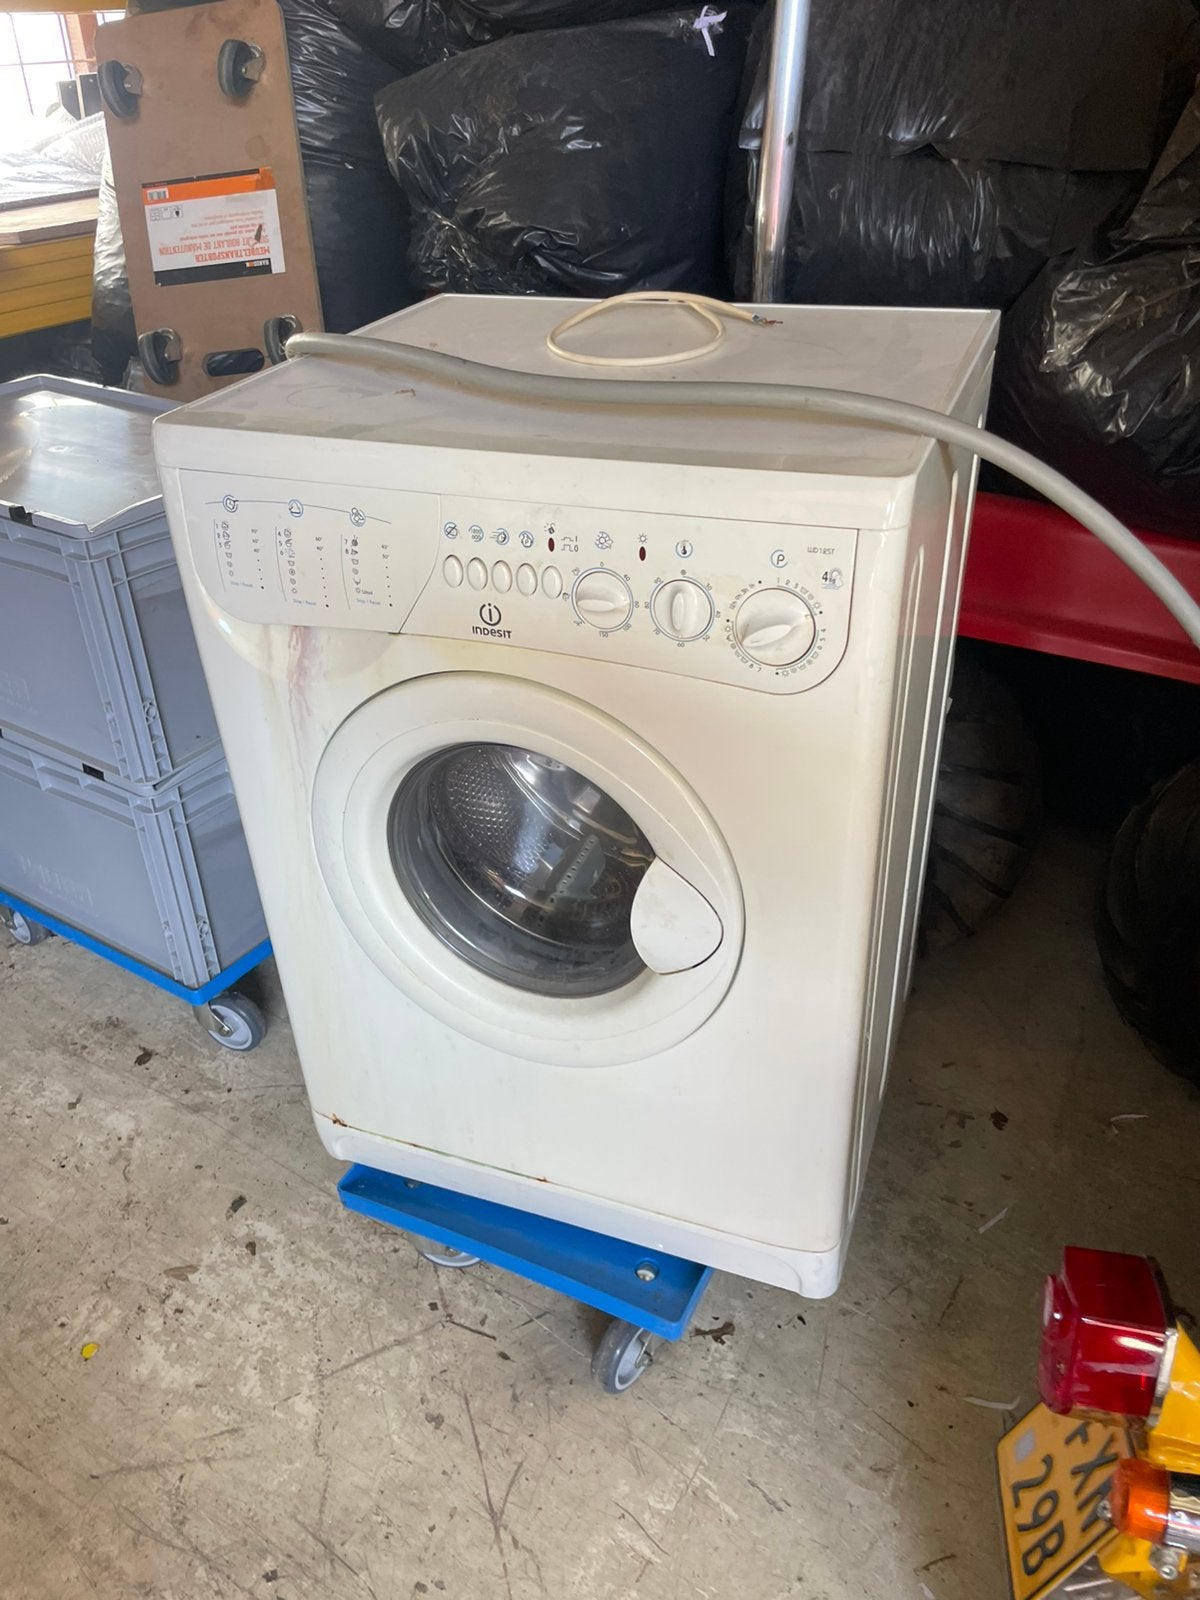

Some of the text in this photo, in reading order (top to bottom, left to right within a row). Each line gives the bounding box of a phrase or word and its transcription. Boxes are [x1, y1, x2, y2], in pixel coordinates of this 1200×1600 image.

[202, 242, 211, 250] DE
[196, 247, 270, 262] MEUBELTRANSPORTER
[1011, 1453, 1066, 1577] 29B
